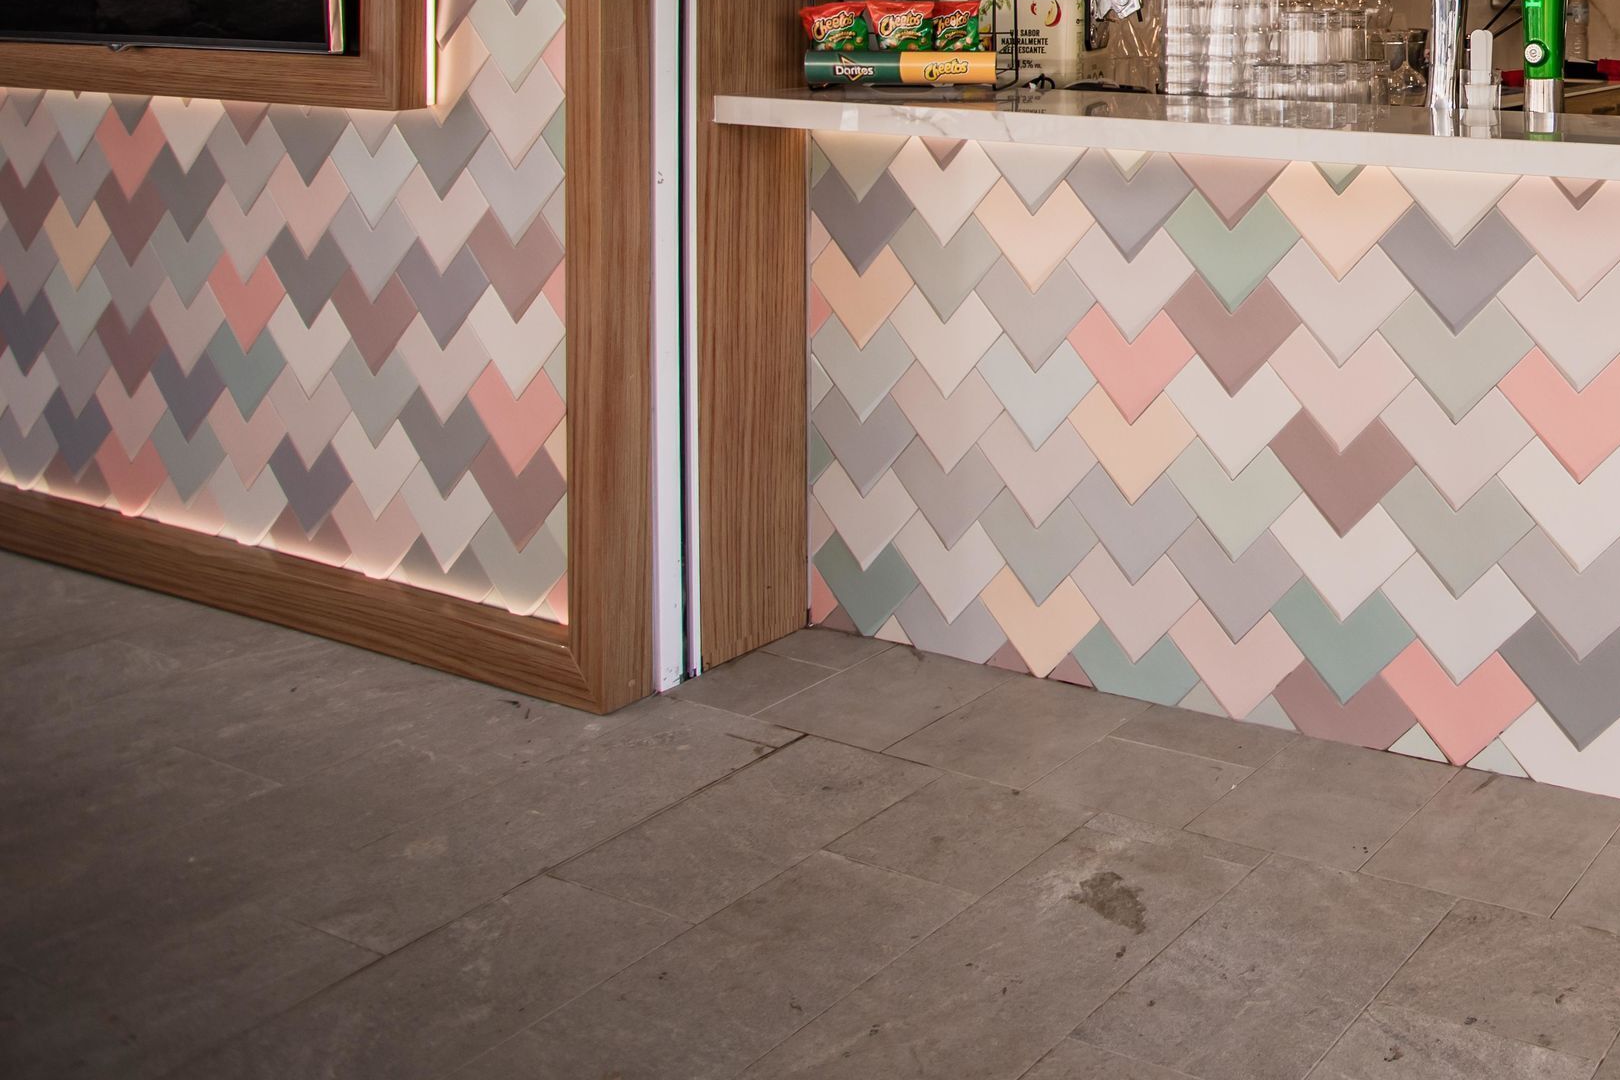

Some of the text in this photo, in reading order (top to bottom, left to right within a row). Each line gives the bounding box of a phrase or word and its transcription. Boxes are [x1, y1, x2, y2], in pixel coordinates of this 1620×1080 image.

[812, 12, 854, 39] Cheetos
[879, 12, 922, 35] Cheetos
[1020, 29, 1040, 37] SABOR
[835, 65, 874, 77] Doritos
[924, 59, 968, 79] Cheetos
